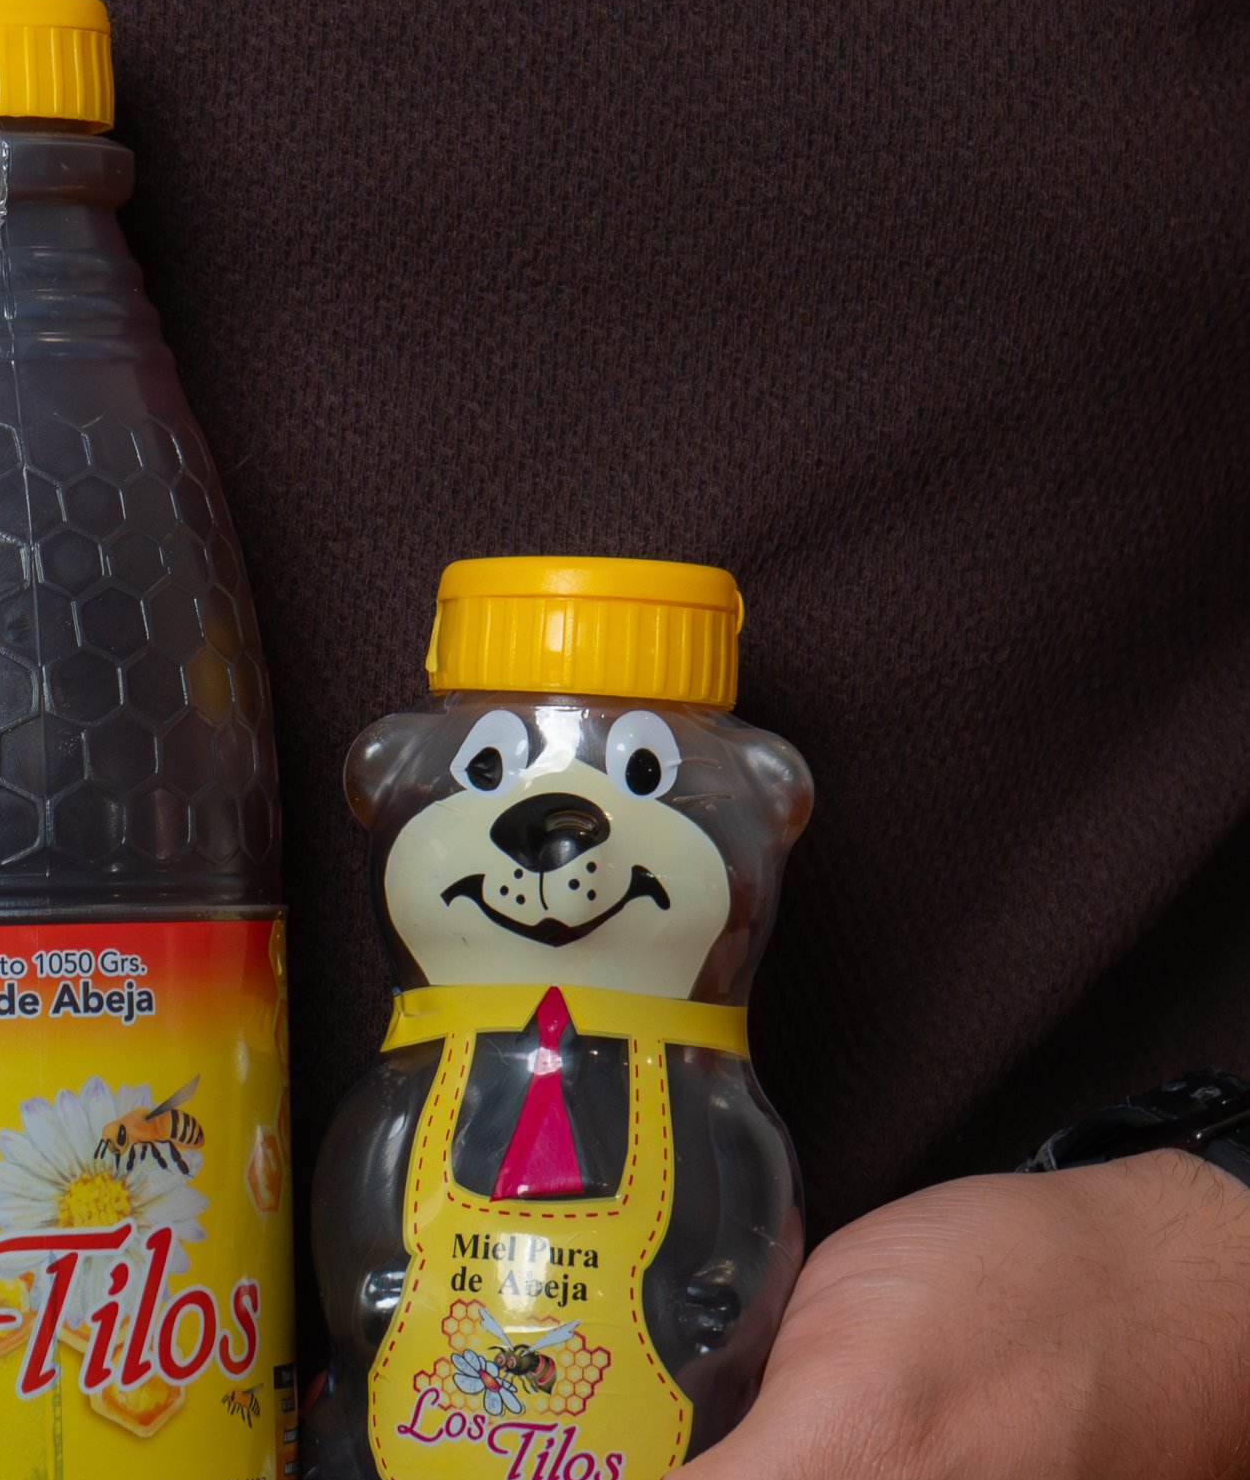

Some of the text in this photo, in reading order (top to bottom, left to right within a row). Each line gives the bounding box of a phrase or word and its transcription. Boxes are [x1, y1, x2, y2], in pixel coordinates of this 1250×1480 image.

[35, 951, 93, 976] 1050
[99, 950, 146, 974] Grs.
[51, 980, 154, 1024] Abeja
[452, 1233, 599, 1269] Miel Pura
[450, 1266, 588, 1308] de Abeja
[396, 1387, 486, 1443] Los
